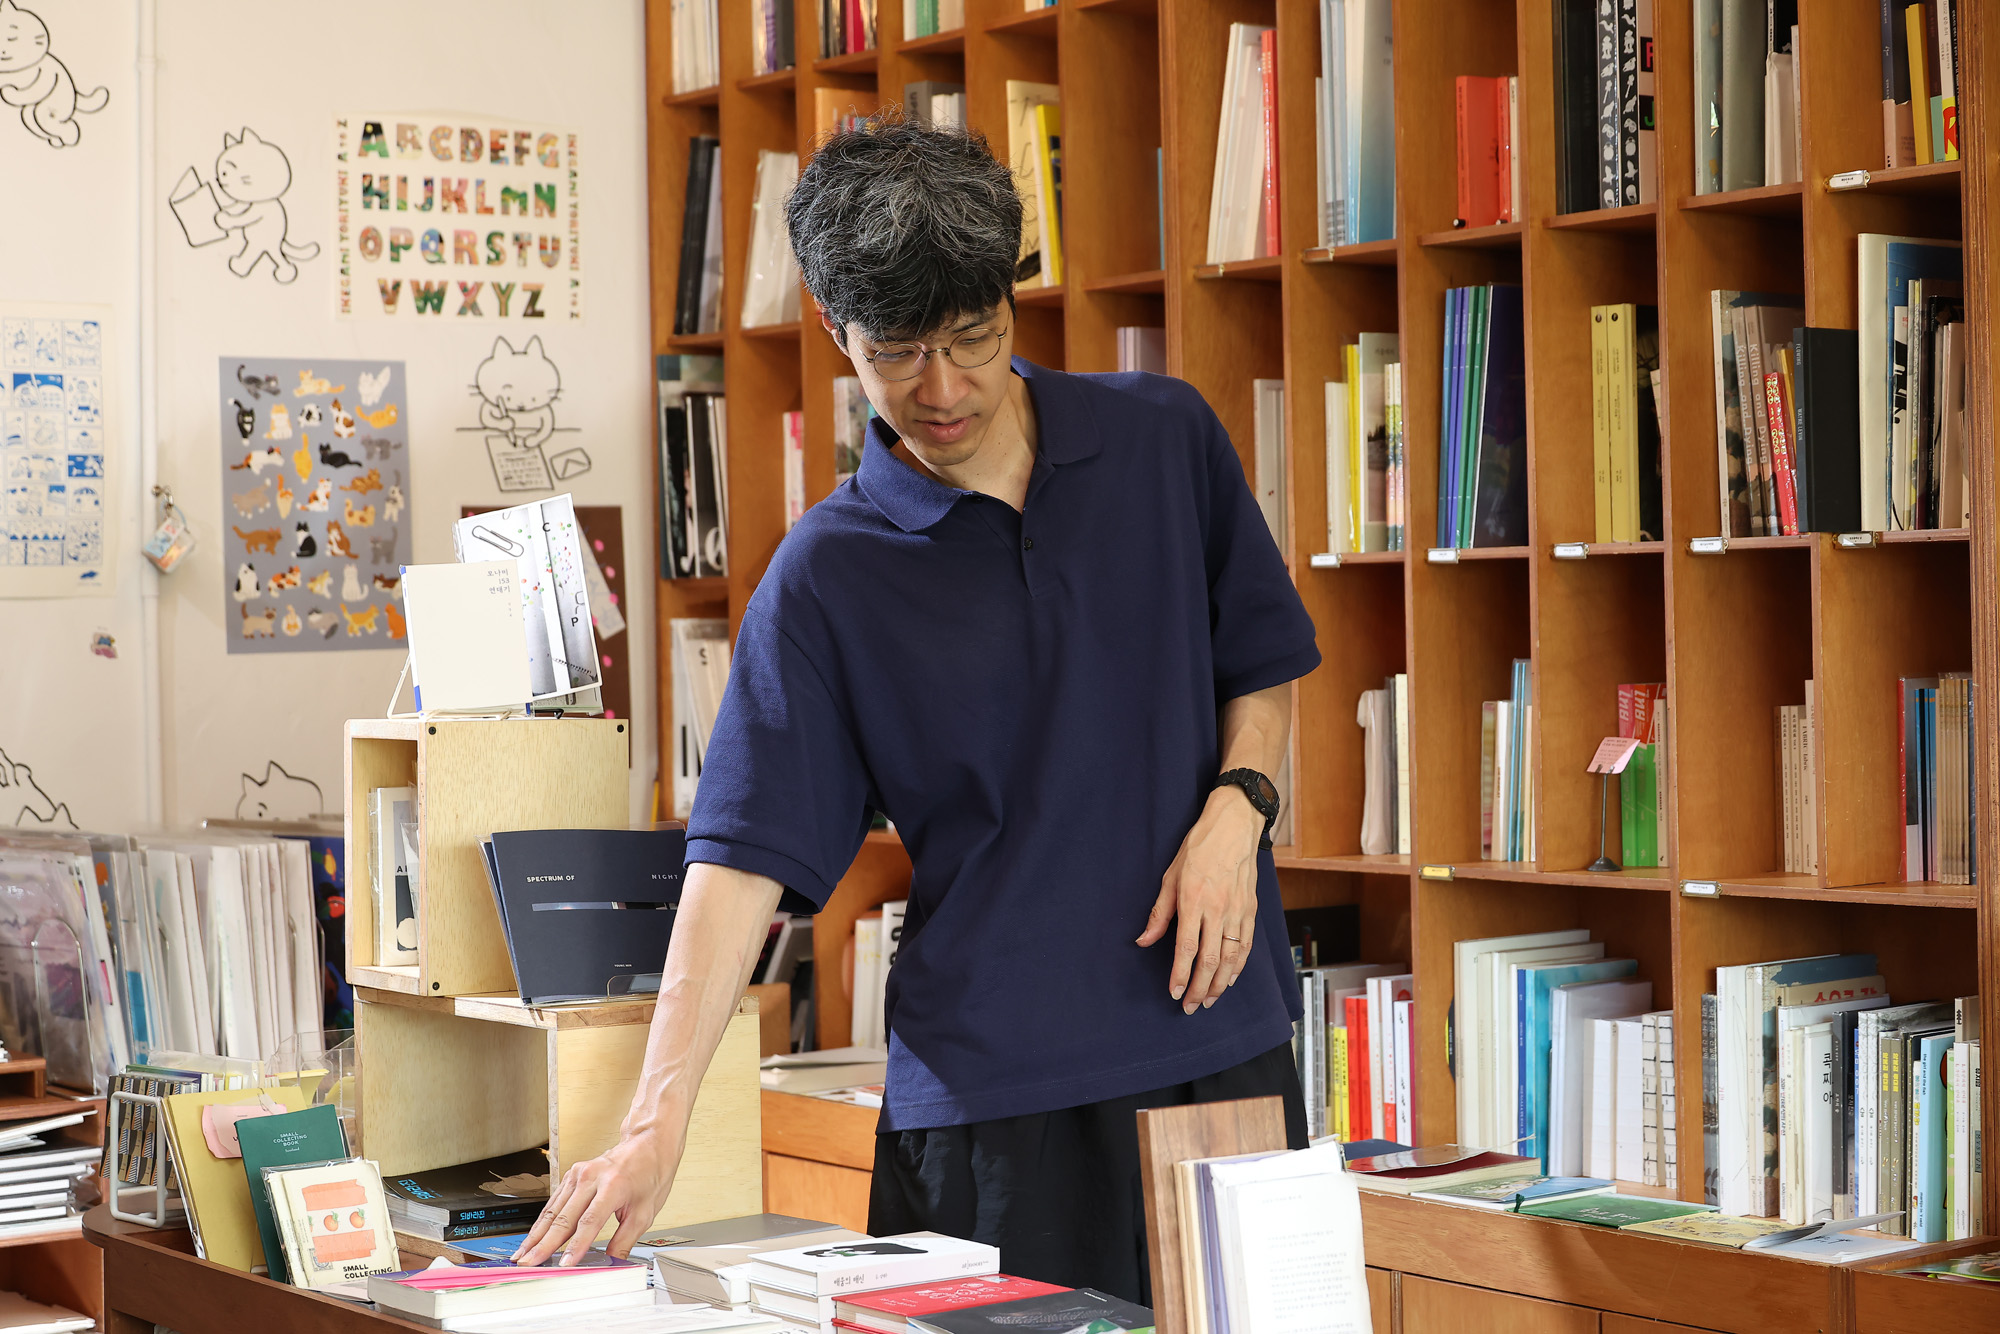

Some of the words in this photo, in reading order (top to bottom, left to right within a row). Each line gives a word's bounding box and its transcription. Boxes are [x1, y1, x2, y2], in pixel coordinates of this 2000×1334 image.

[1736, 345, 1746, 387] Killing
[1749, 344, 1760, 386] Killing
[1741, 394, 1751, 419] and
[1755, 393, 1766, 418] and
[1744, 427, 1755, 465] Dying
[1757, 425, 1768, 464] Dying
[498, 577, 510, 585] 153
[526, 874, 564, 883] SPECTRUM
[565, 874, 576, 882] OF
[273, 1134, 308, 1144] COLLECTING
[459, 1210, 486, 1221] 되바라진
[342, 1264, 369, 1272] SMALL
[344, 1266, 393, 1280] COLLECTING
